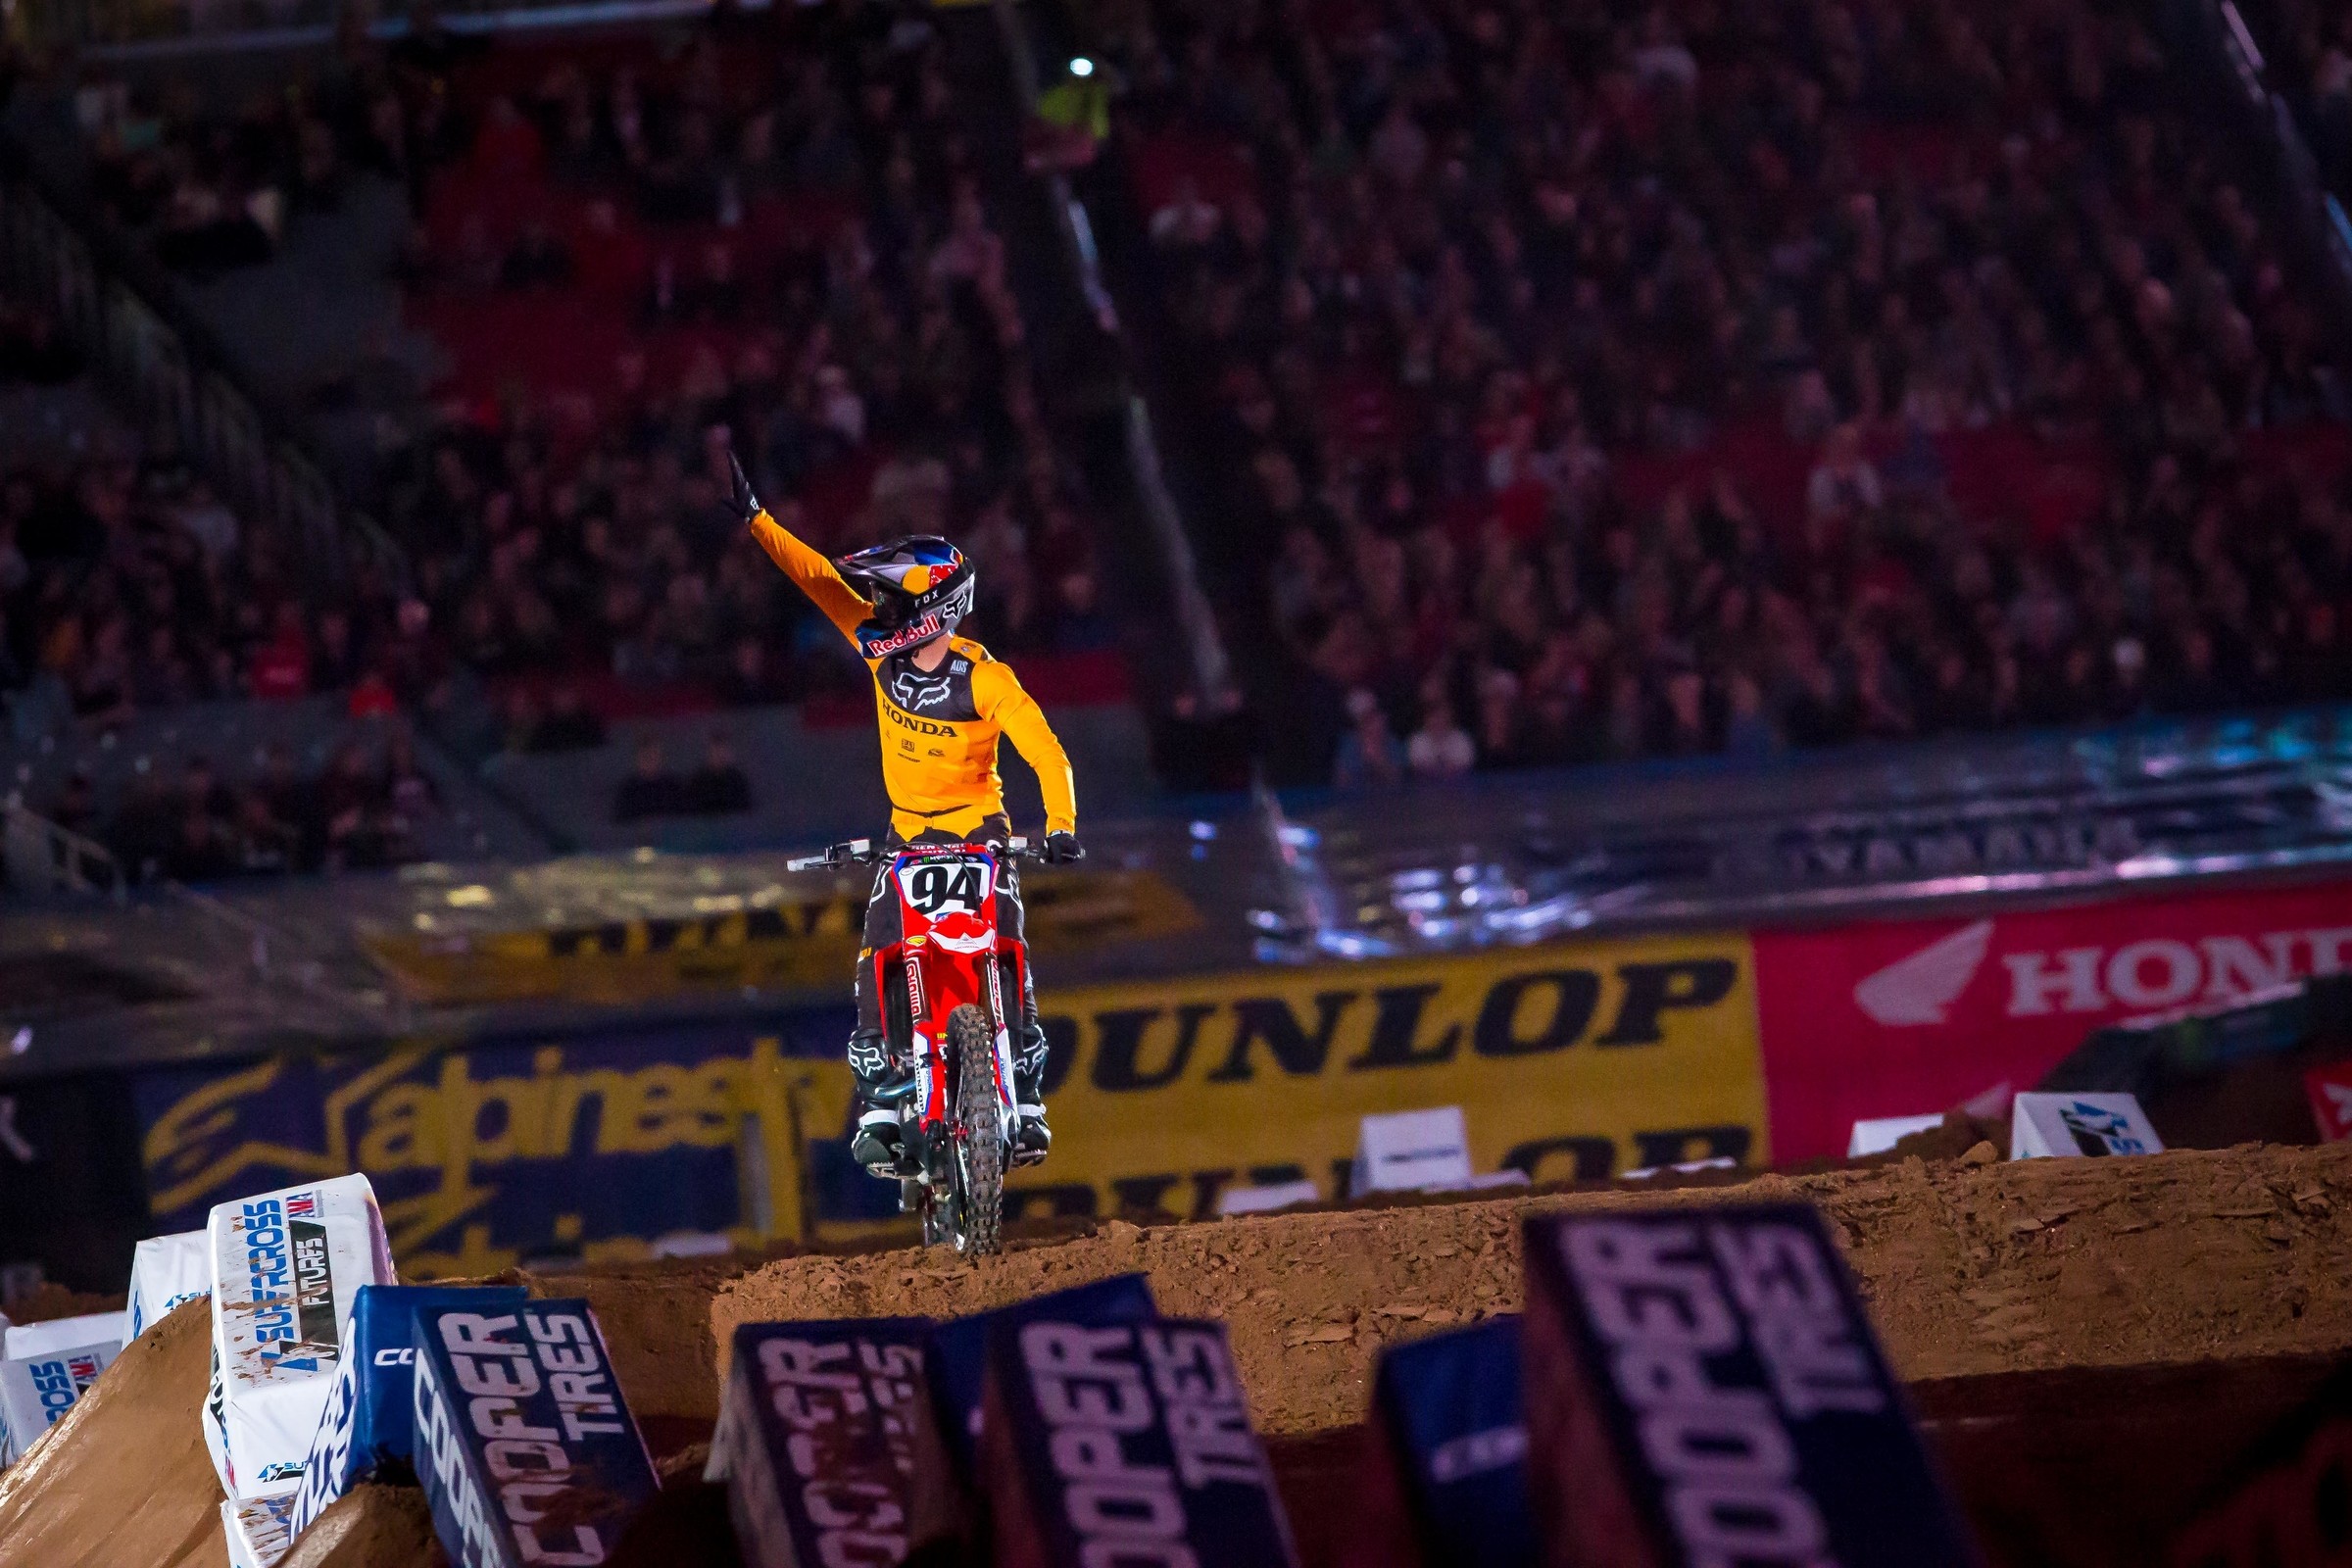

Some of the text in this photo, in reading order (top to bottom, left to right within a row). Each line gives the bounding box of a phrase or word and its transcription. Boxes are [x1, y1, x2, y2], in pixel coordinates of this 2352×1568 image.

[914, 590, 939, 608] FOX
[883, 699, 958, 738] HONDA
[912, 865, 984, 915] 94
[295, 1238, 329, 1307] FUTURES
[524, 1314, 625, 1442] TIRES
[1558, 1223, 1838, 1568] OOPER
